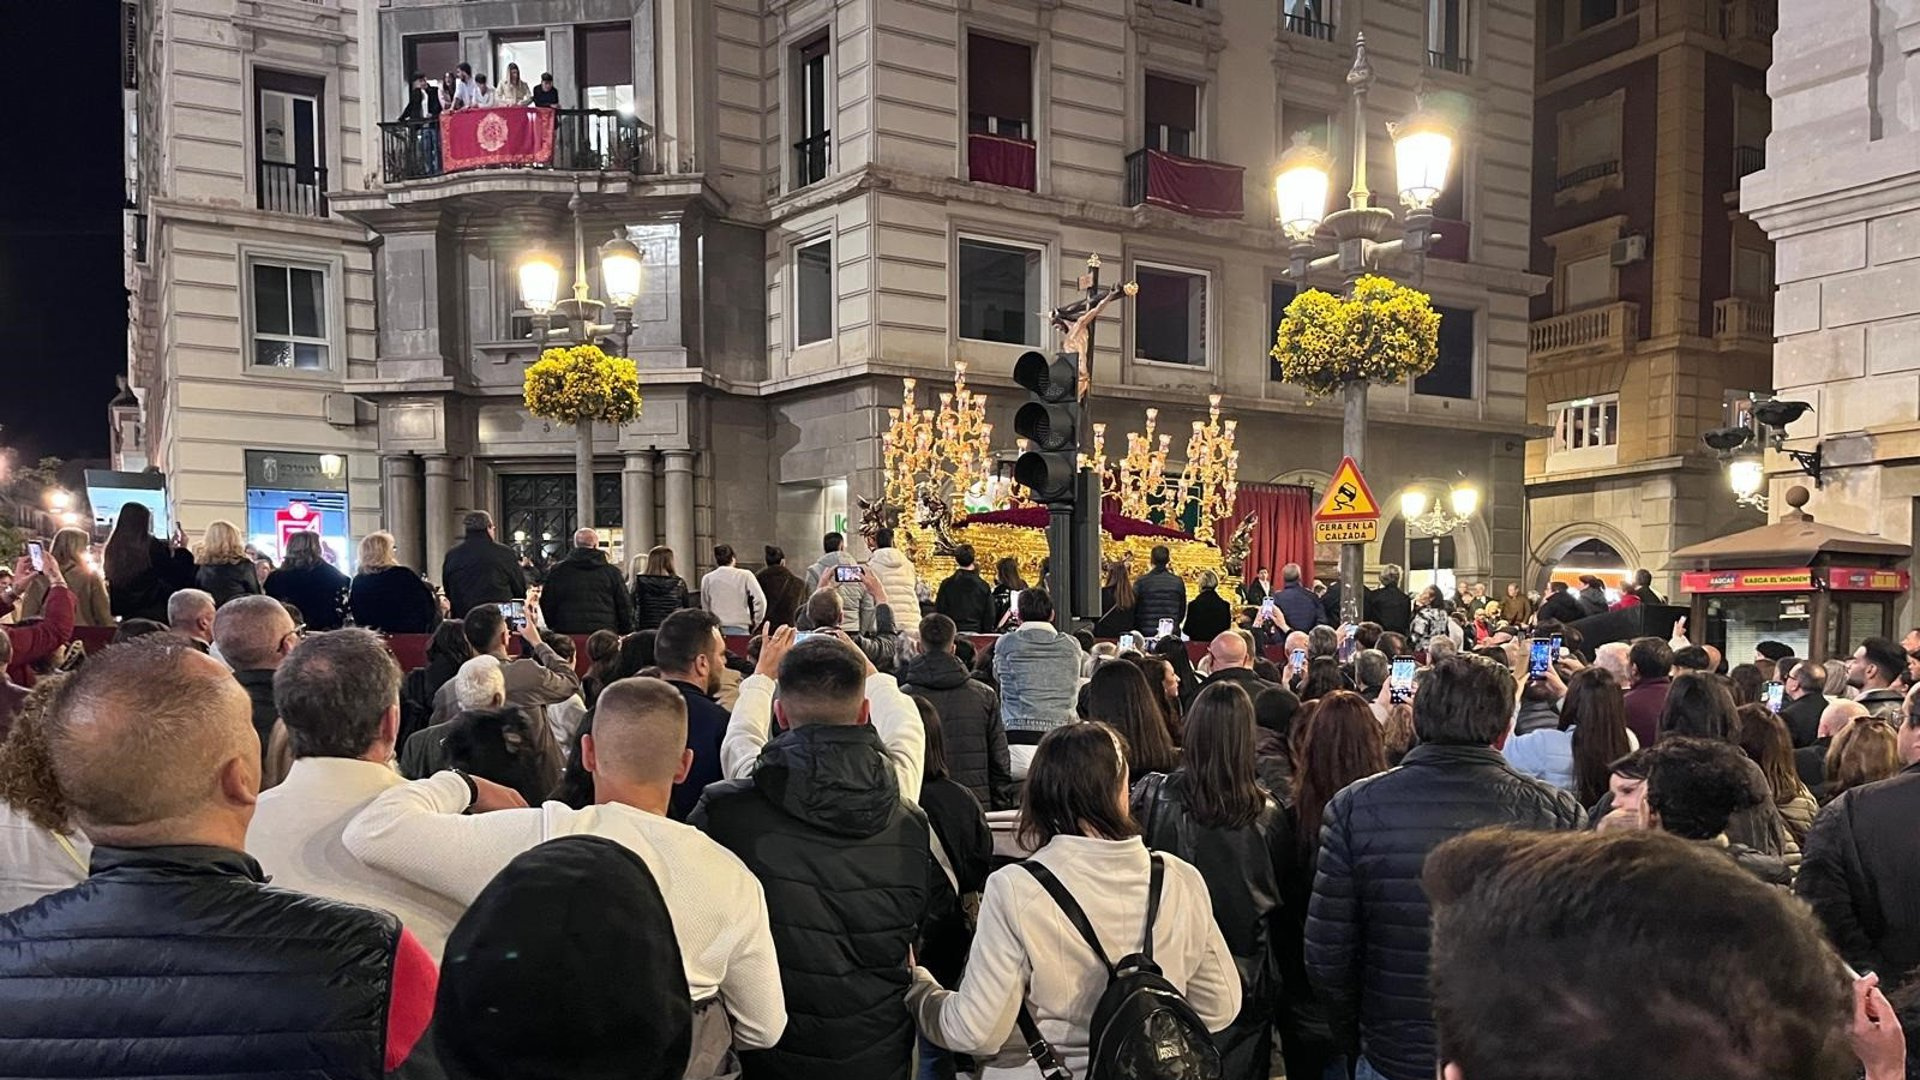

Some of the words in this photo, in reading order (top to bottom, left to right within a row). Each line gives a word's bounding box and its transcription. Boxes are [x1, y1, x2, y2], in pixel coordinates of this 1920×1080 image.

[1319, 523, 1343, 531] CERA
[1347, 522, 1359, 530] EN
[1325, 532, 1367, 540] CALZADA
